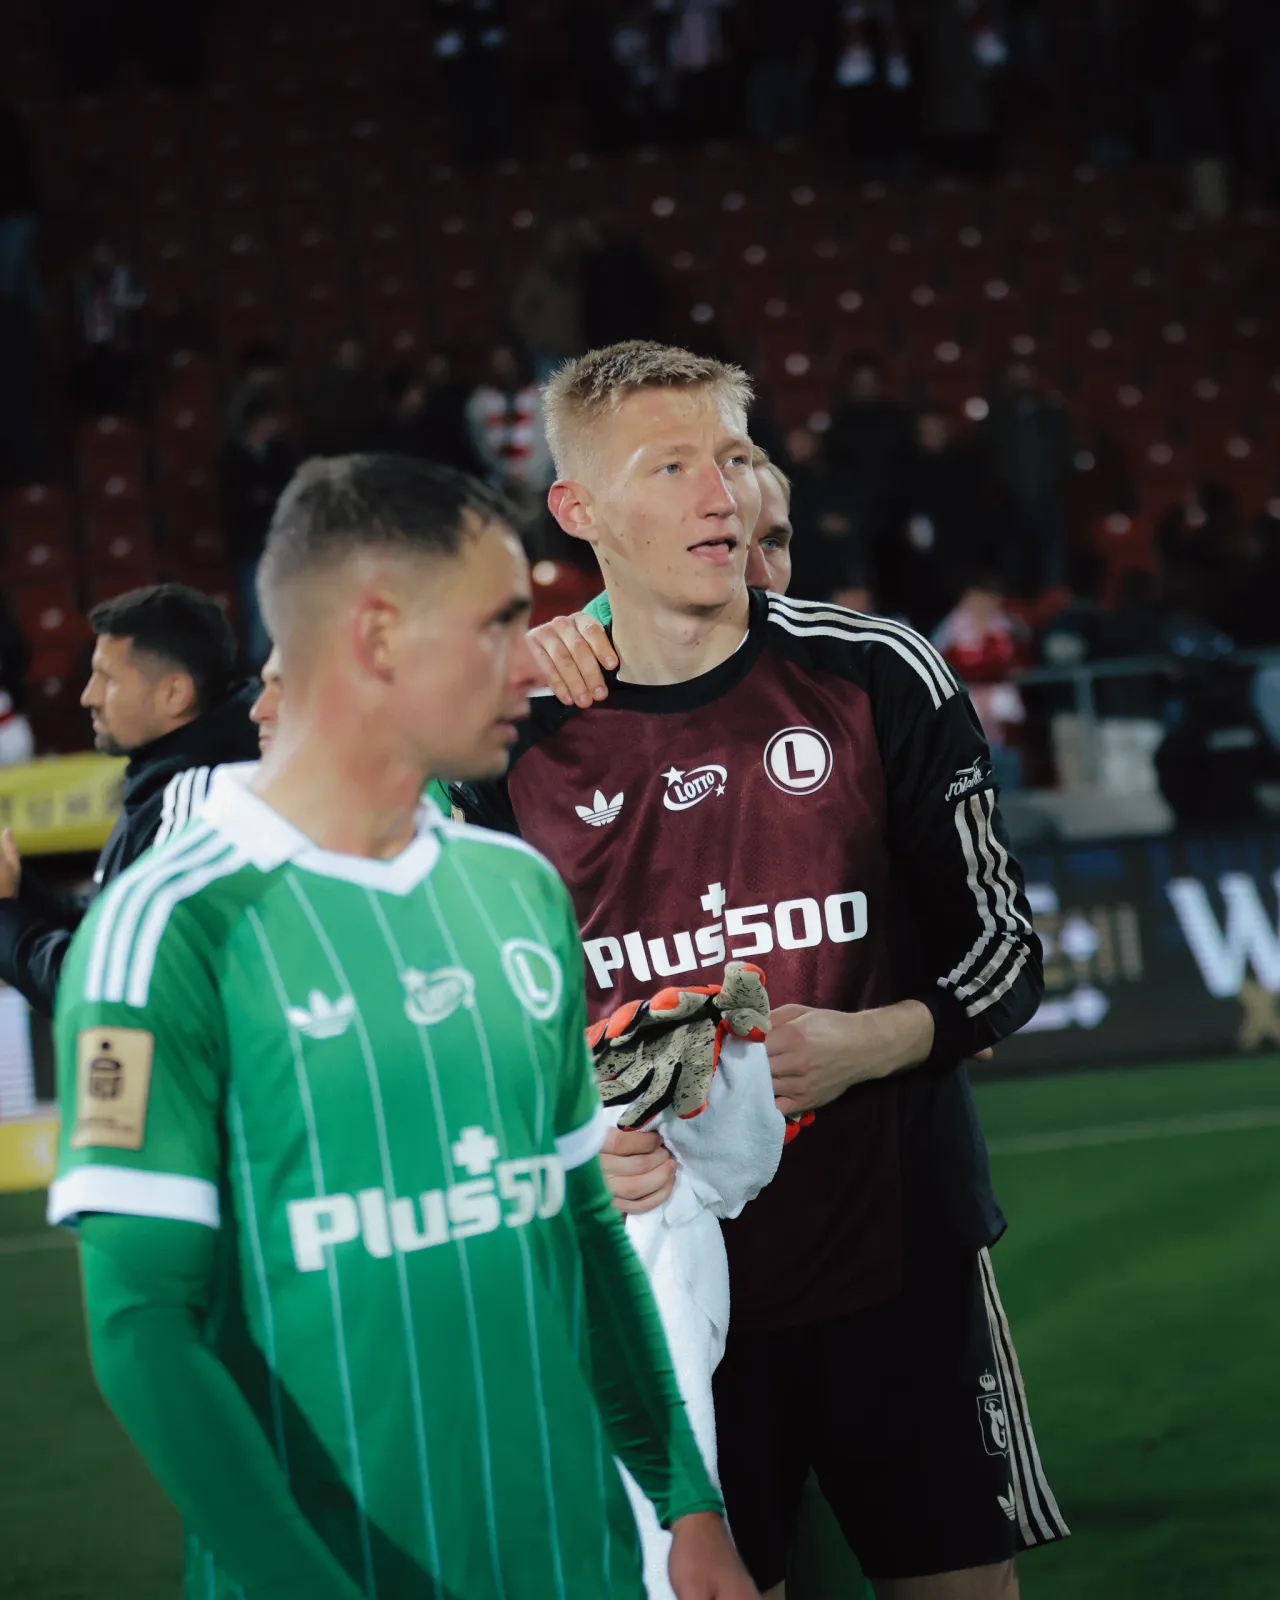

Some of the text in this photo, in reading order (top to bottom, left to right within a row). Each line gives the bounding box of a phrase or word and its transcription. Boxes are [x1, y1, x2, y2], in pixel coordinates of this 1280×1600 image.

[784, 740, 816, 781] L
[673, 771, 715, 803] LOTTO
[582, 890, 868, 989] Plus500
[514, 952, 550, 1001] L
